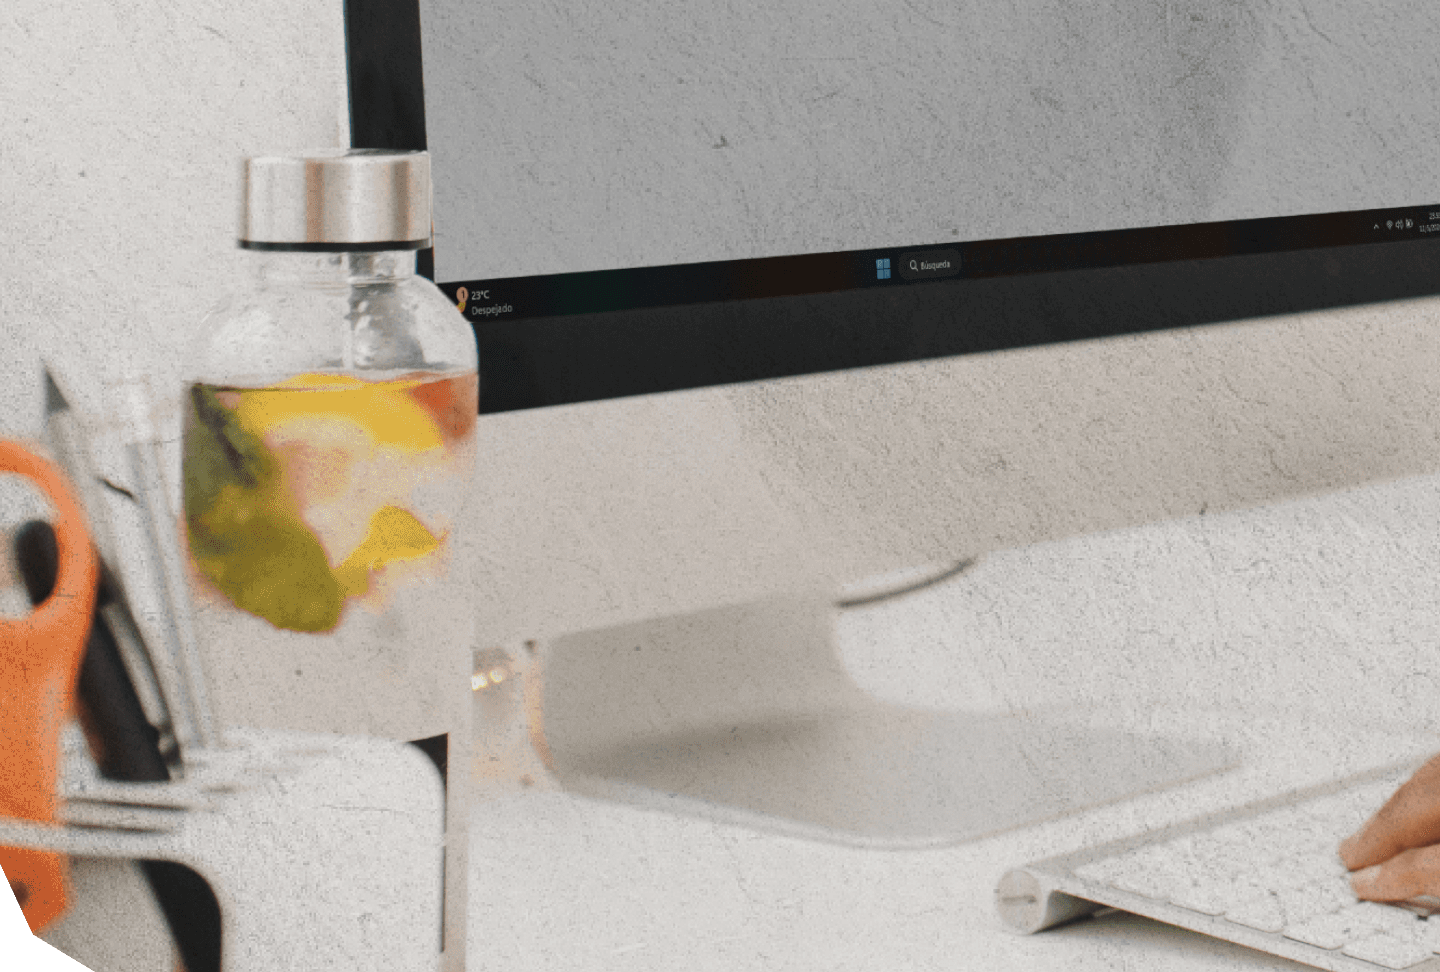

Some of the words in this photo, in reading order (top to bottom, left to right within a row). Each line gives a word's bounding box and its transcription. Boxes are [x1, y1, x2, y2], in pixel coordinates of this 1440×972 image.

[920, 259, 951, 272] Búsqueda
[471, 289, 490, 301] 23°C
[471, 303, 513, 317] Despejado
